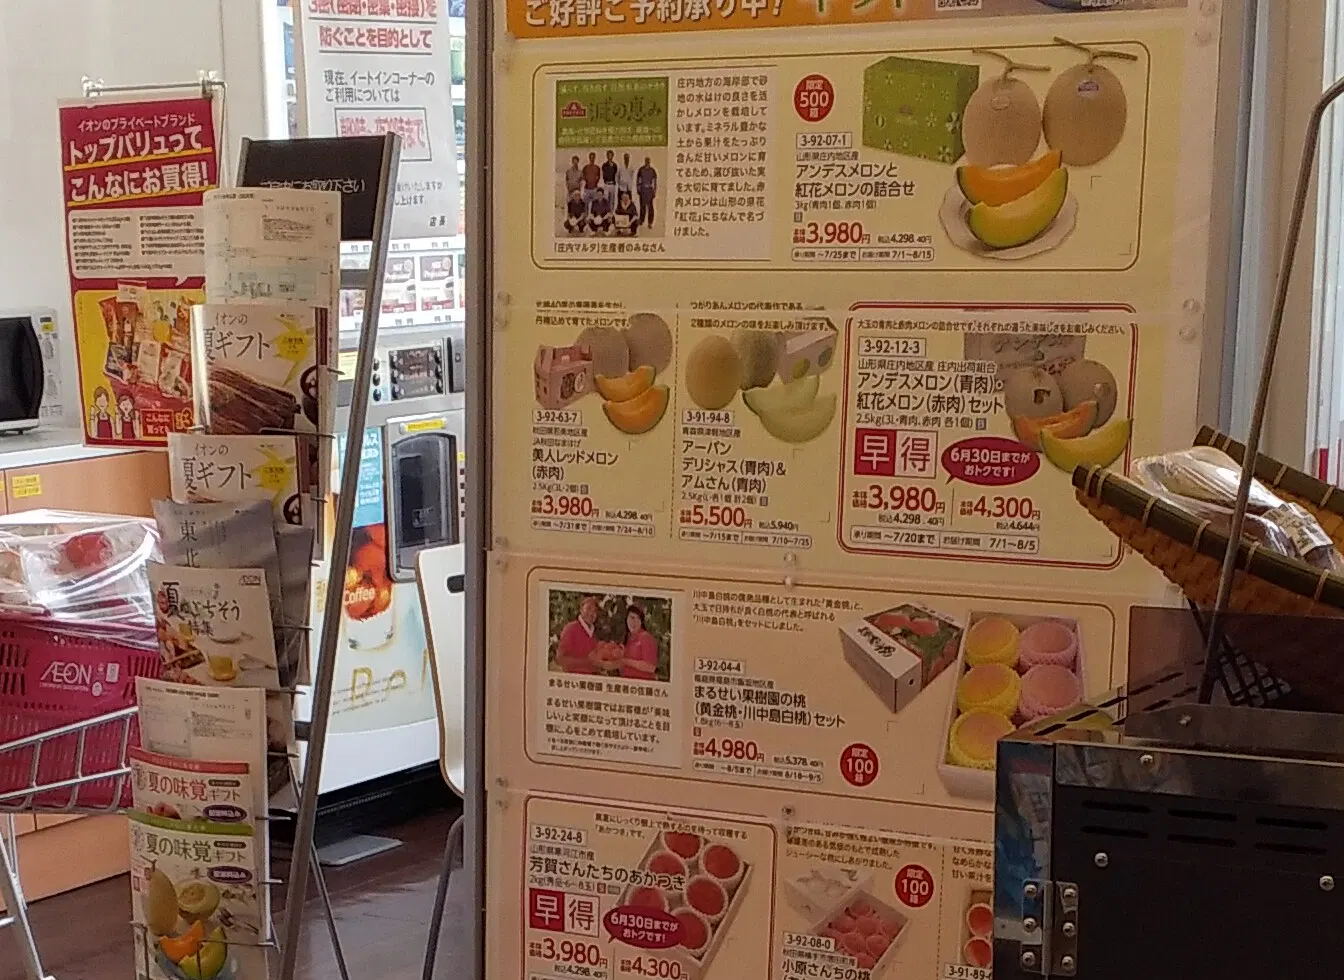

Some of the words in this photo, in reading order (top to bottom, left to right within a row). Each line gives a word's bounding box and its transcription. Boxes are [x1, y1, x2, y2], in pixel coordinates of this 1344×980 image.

[319, 25, 432, 48] 防ぐことを目的として
[324, 70, 434, 86] 現在、イートインコーナーの
[326, 88, 400, 103] ご利用については
[799, 92, 829, 107] 500
[78, 113, 195, 132] イオンのプライベートブランド
[69, 125, 202, 167] トップバリュって
[801, 135, 846, 147] 3-92-07-1
[796, 163, 898, 179] アンデスメロンと
[71, 161, 208, 201] こんなにお買得!
[794, 181, 916, 198] 紅花メロンの詰合せ
[674, 227, 710, 236] けました。
[807, 222, 871, 244] 3,980円
[864, 339, 920, 354] 3-92-12-3
[858, 359, 934, 372] 山形県庄内地区産
[856, 392, 966, 413] 紅花メロン(赤肉)
[969, 396, 1004, 415] セット
[536, 412, 578, 422] 3-92-63-7
[686, 411, 730, 423] 3-91-94-8
[532, 448, 619, 466] 美人レッドメロン
[860, 435, 930, 472] 早得
[951, 447, 1031, 464] 6月30日までが
[532, 466, 564, 481] (赤肉)
[682, 457, 786, 477] デリシャス(青肉)&
[964, 463, 1015, 477] おトクです!
[681, 474, 767, 494] アムさん(青肉)
[543, 495, 600, 518] 3,980円
[868, 484, 946, 513] 3,980円
[974, 496, 1041, 520] 4,300円
[692, 504, 753, 528] 5,500円
[343, 585, 376, 604] Coffee
[699, 660, 741, 672] 3-92-04-4
[695, 686, 806, 708] まるせい果樹園の桃
[695, 702, 812, 726] (黄金桃・川中島白桃)
[815, 713, 845, 728] セット
[705, 738, 764, 762] 4,980円
[847, 758, 873, 774] 100
[148, 771, 208, 801] 夏の味覚
[210, 790, 241, 801] ギフト
[535, 828, 582, 843] 3-92-24-8
[147, 833, 212, 862] 夏の味覚
[216, 851, 246, 863] ギフト
[530, 856, 685, 891] 芳賀さんたちのあかつき
[902, 880, 928, 896] 100
[534, 895, 594, 931] 早得
[611, 912, 678, 931] 6月30日までが
[623, 929, 666, 943] おトクです!
[787, 934, 831, 950] 3-92-08-0
[543, 938, 607, 968] 3,980円
